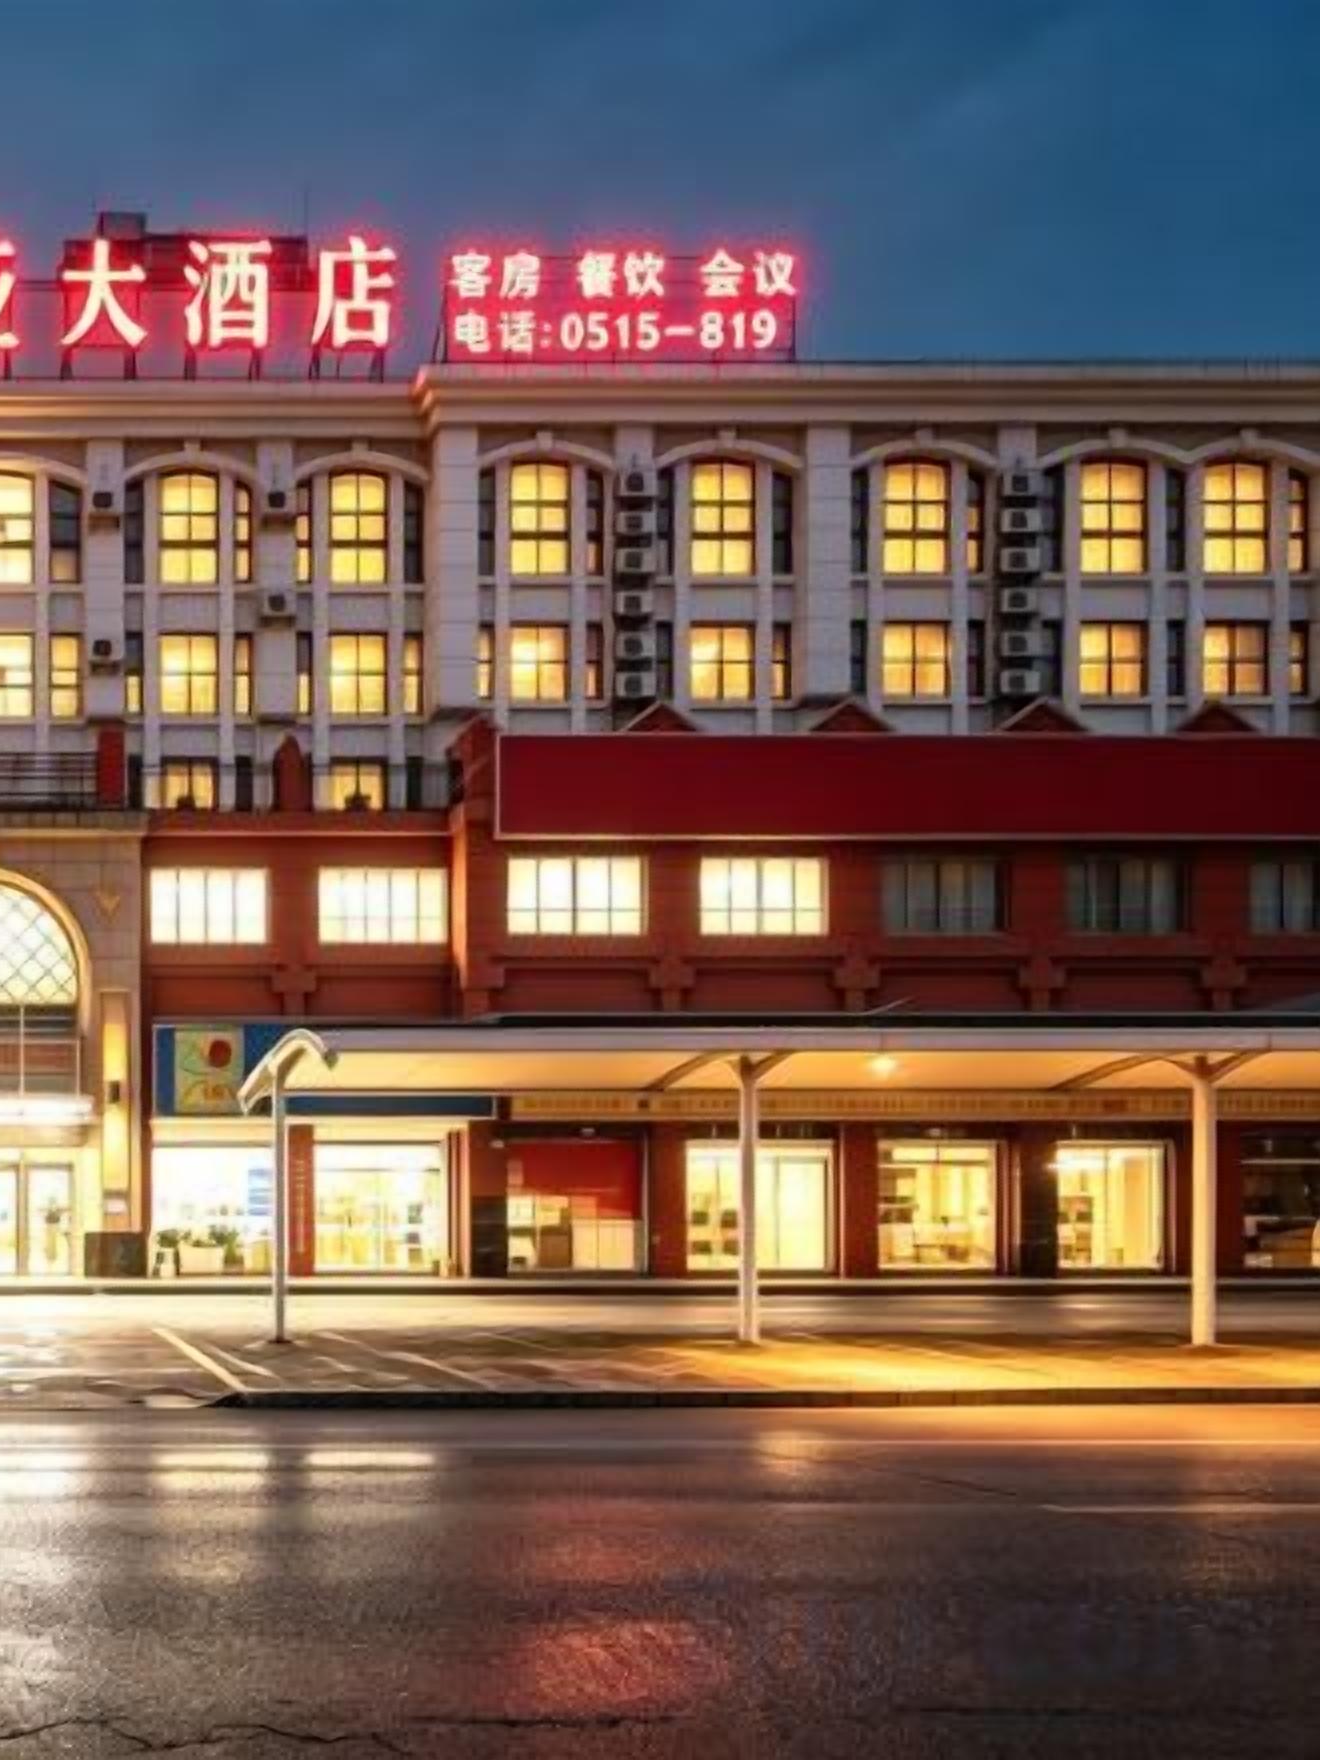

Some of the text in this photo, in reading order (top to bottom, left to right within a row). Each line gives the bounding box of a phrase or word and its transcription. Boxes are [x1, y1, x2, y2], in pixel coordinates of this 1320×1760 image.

[451, 249, 796, 299] 客房 餐饮 会议
